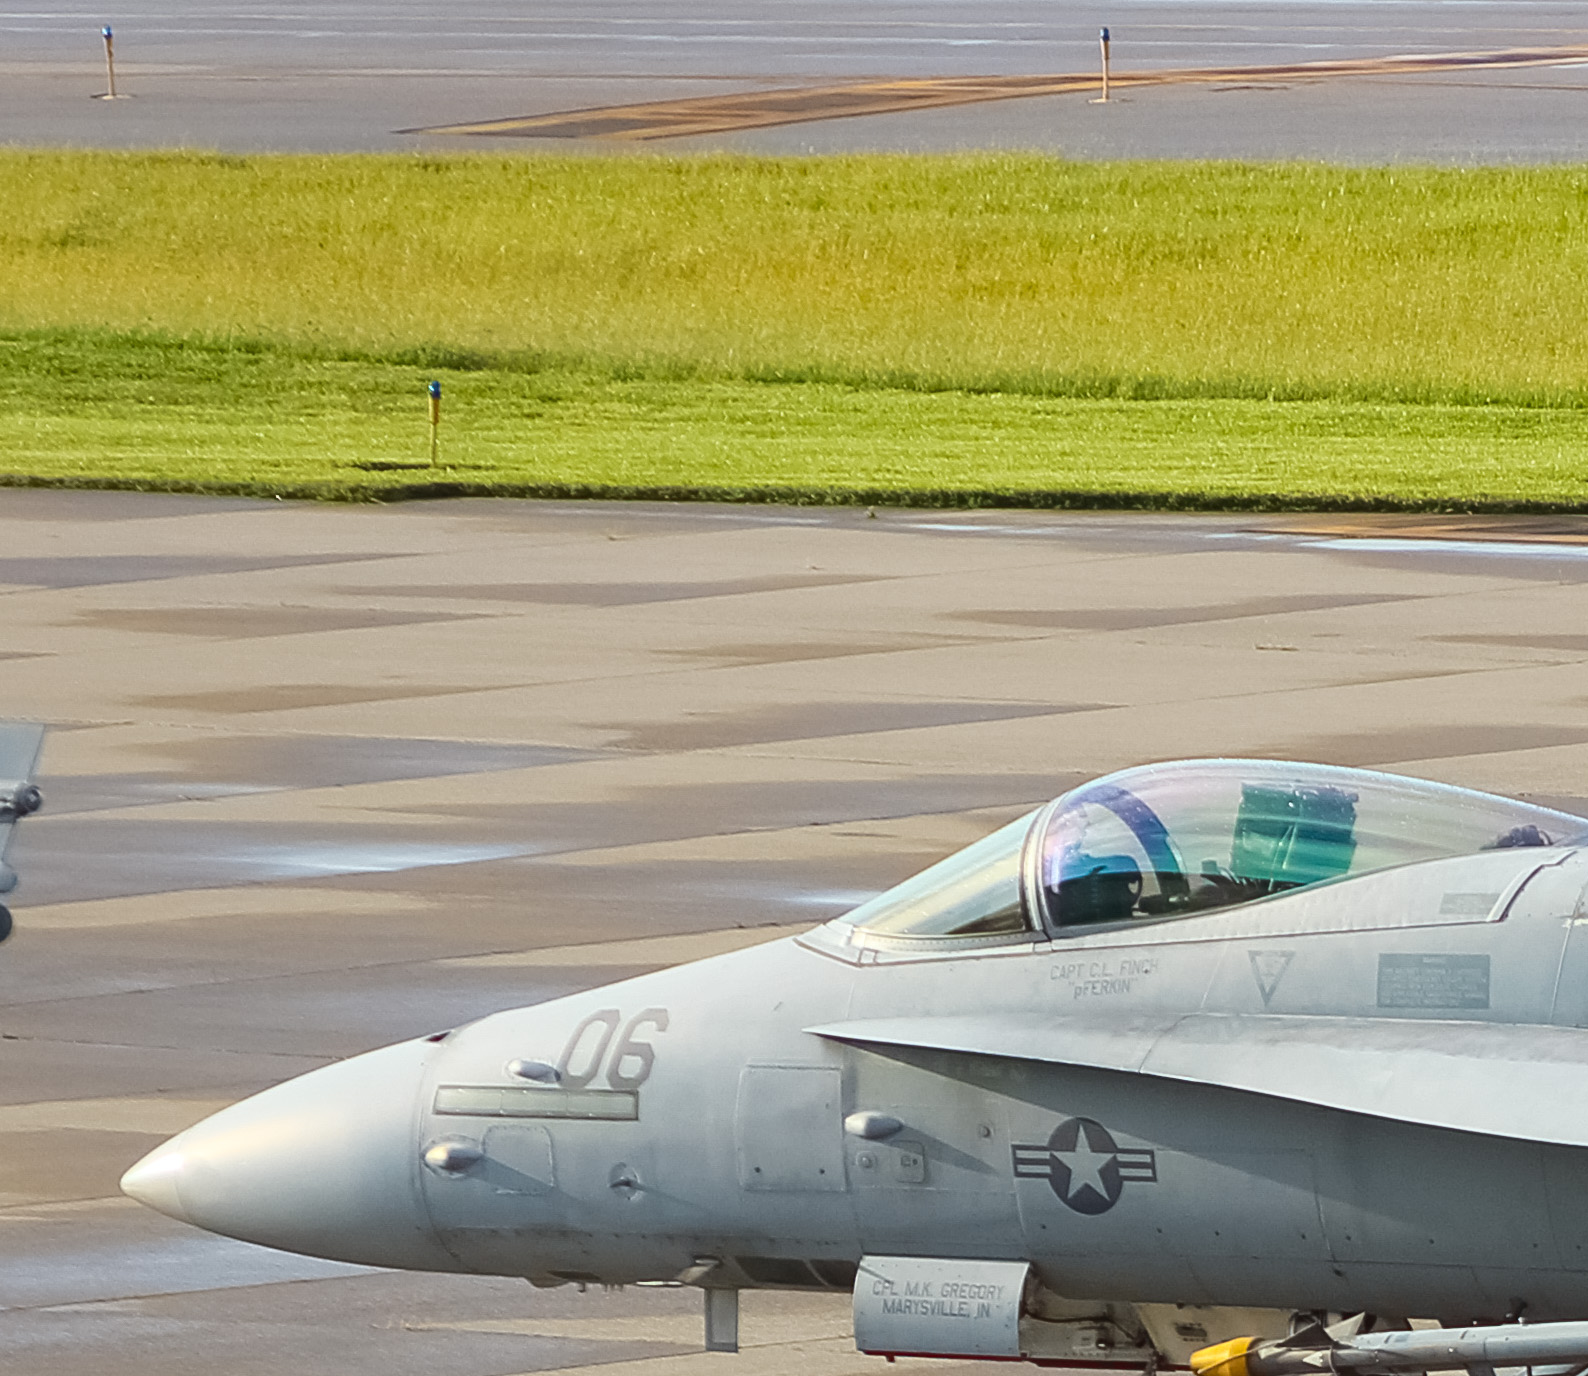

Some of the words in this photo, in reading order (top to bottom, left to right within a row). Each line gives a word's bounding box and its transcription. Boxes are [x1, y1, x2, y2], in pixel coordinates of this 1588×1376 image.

[1050, 964, 1085, 980] CAPT
[1120, 958, 1159, 975] FINCH
[559, 1008, 668, 1088] 06
[872, 1280, 899, 1296] CPL
[904, 1281, 934, 1297] M.K.
[940, 1283, 1004, 1300] GREGORY
